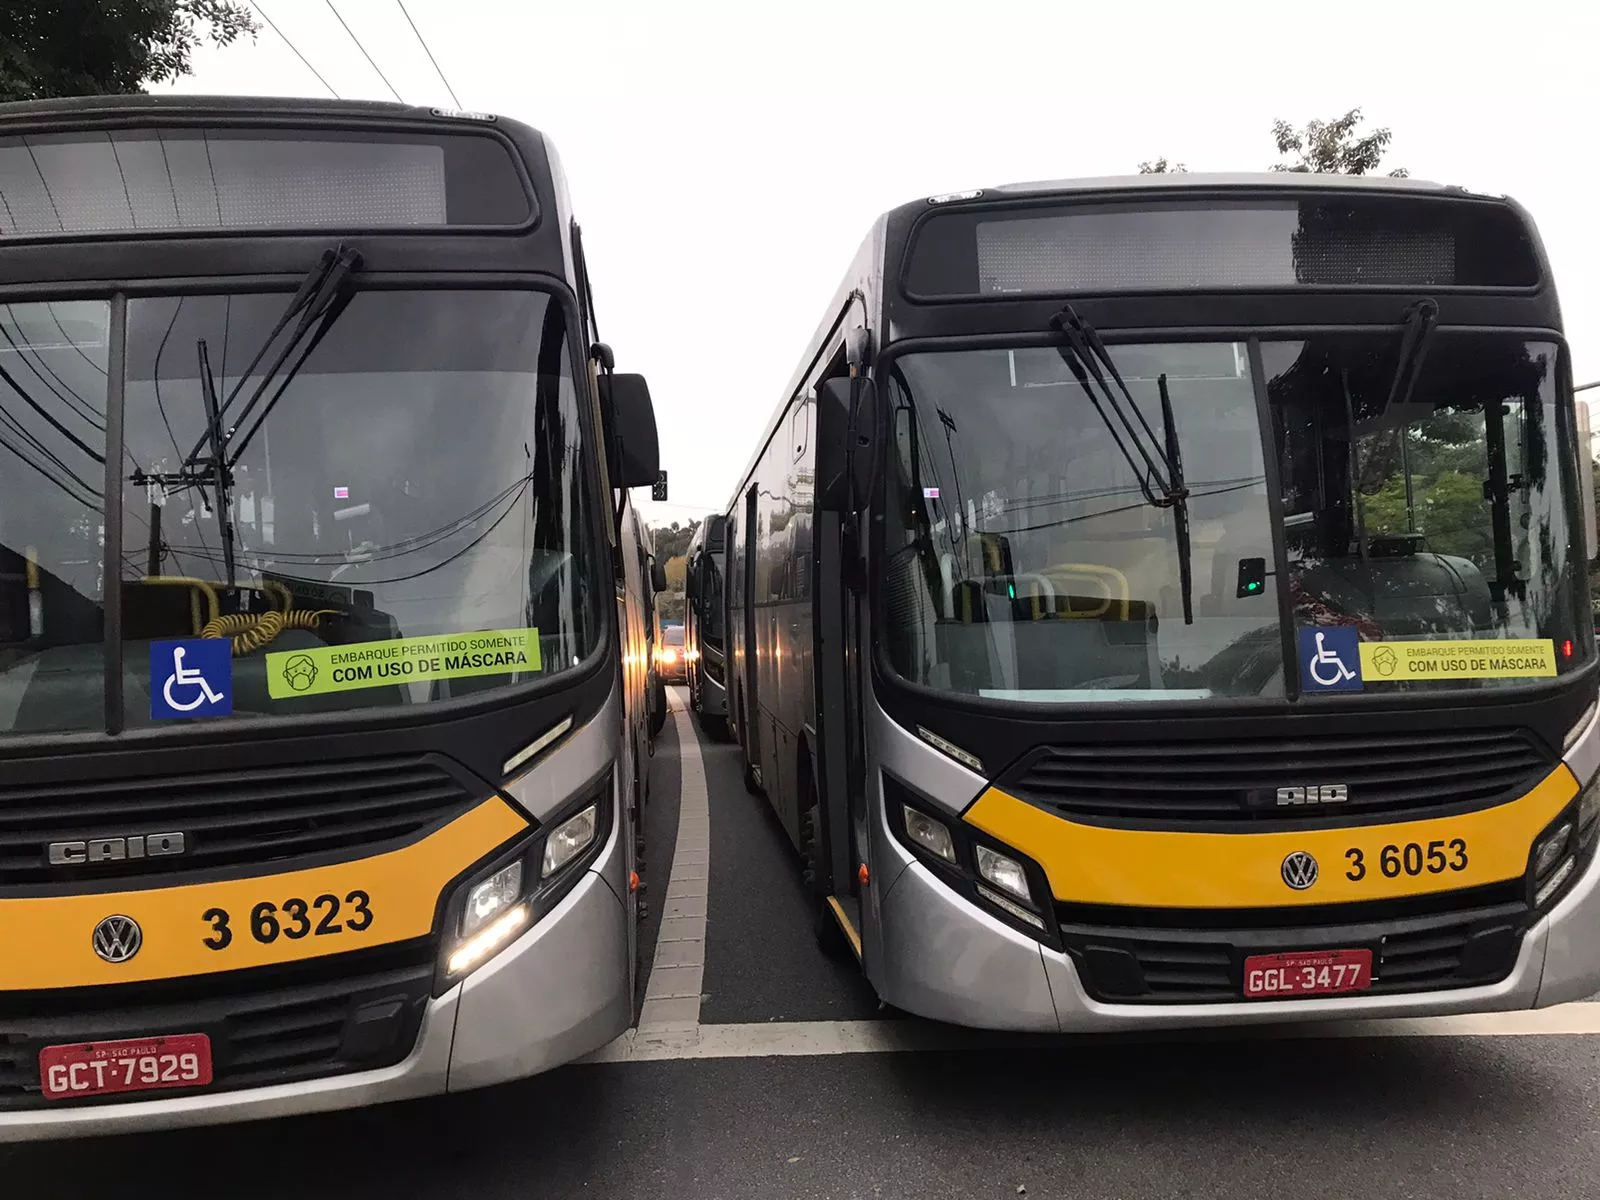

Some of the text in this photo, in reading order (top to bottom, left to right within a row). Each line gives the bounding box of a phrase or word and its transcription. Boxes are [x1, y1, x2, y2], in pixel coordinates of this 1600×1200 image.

[331, 636, 526, 664] EMBARQUE PERMITIDO SOMENTE
[1407, 646, 1545, 657] EMBARQUE PERMITIDO SOMENTE
[1408, 656, 1547, 672] COM USO DE MÁSCARA
[333, 651, 527, 683] COM USO DE MÁSCARA
[48, 831, 185, 865] CAIO
[1344, 838, 1469, 881] 3 6053
[202, 890, 374, 950] 3 6323
[131, 1047, 157, 1055] PAULO
